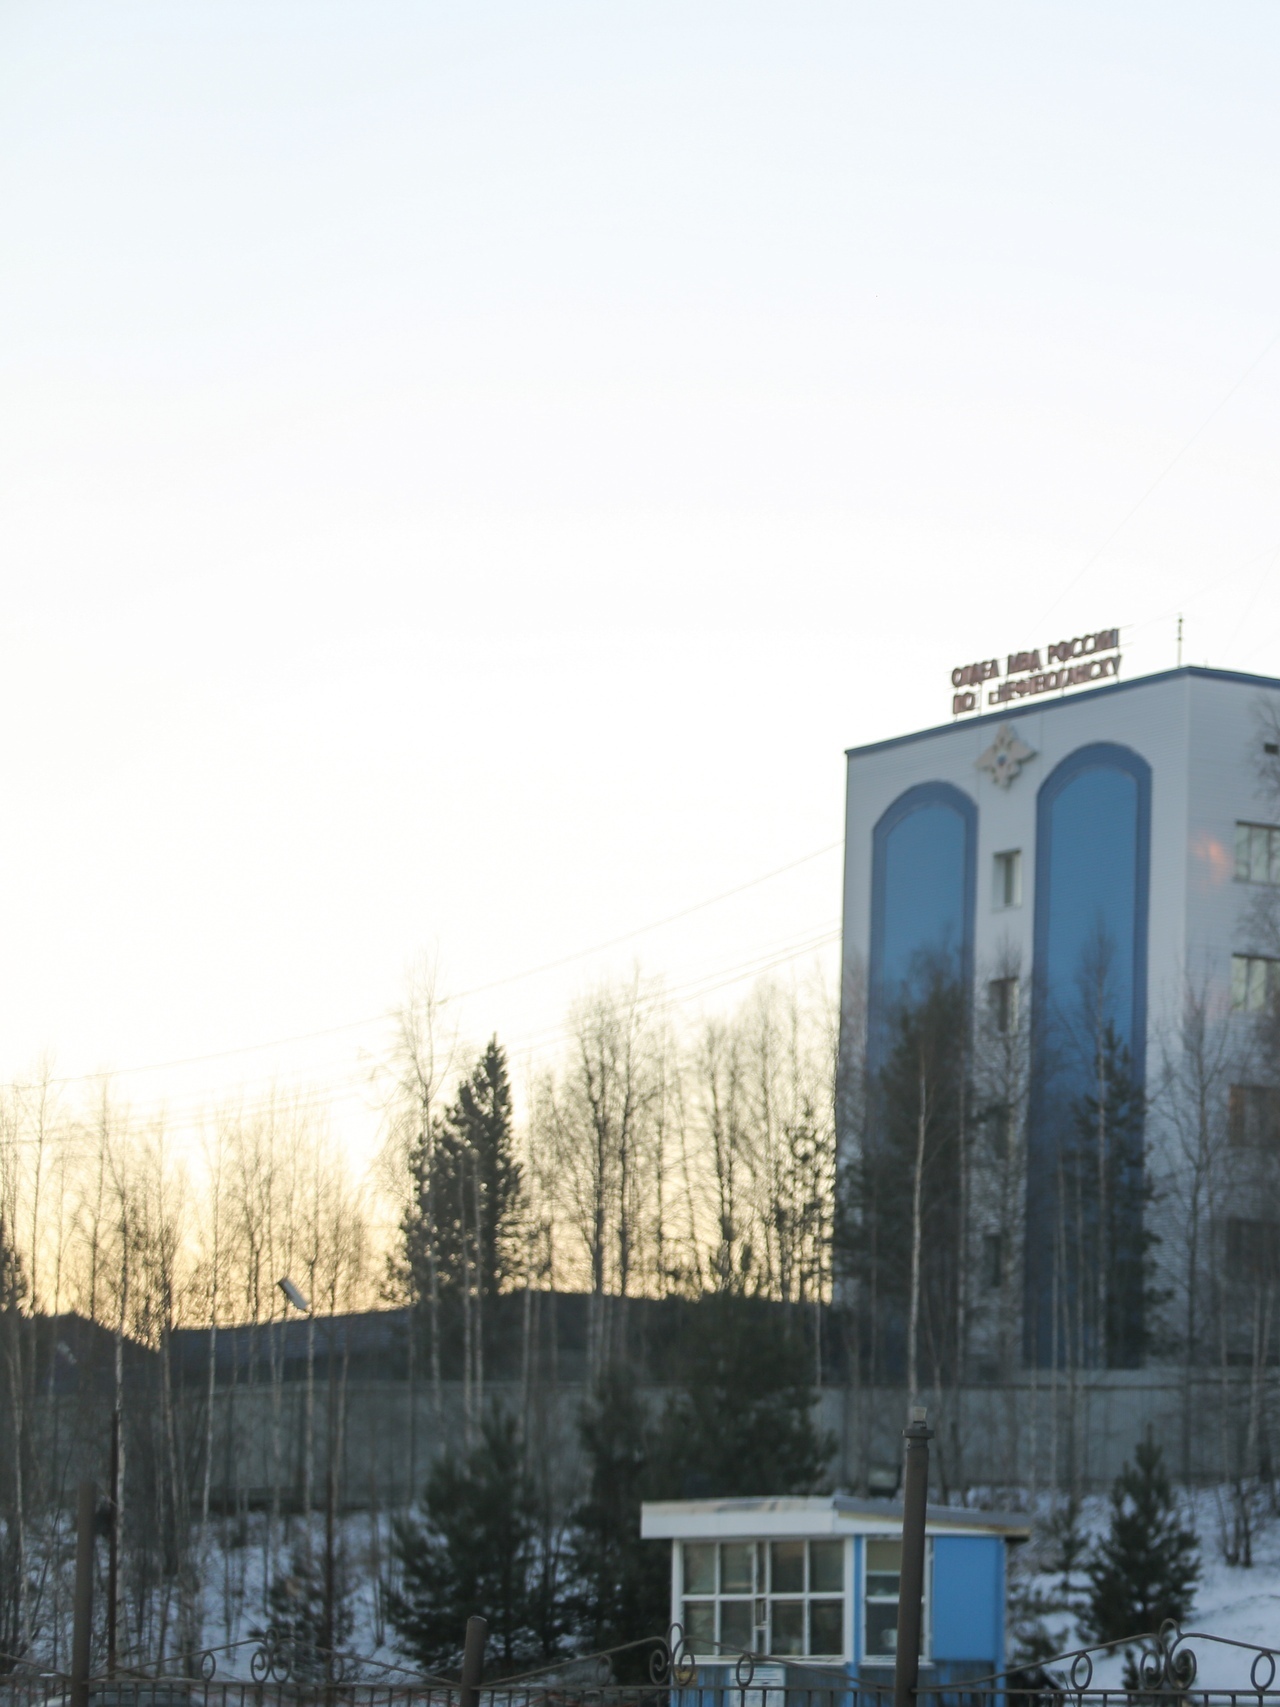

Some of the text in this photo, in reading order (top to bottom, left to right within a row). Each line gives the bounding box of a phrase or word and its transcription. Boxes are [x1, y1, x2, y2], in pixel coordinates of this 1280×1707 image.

[1006, 649, 1042, 675] МВД
[1048, 627, 1120, 665] РОССИИ
[953, 692, 976, 714] ПО
